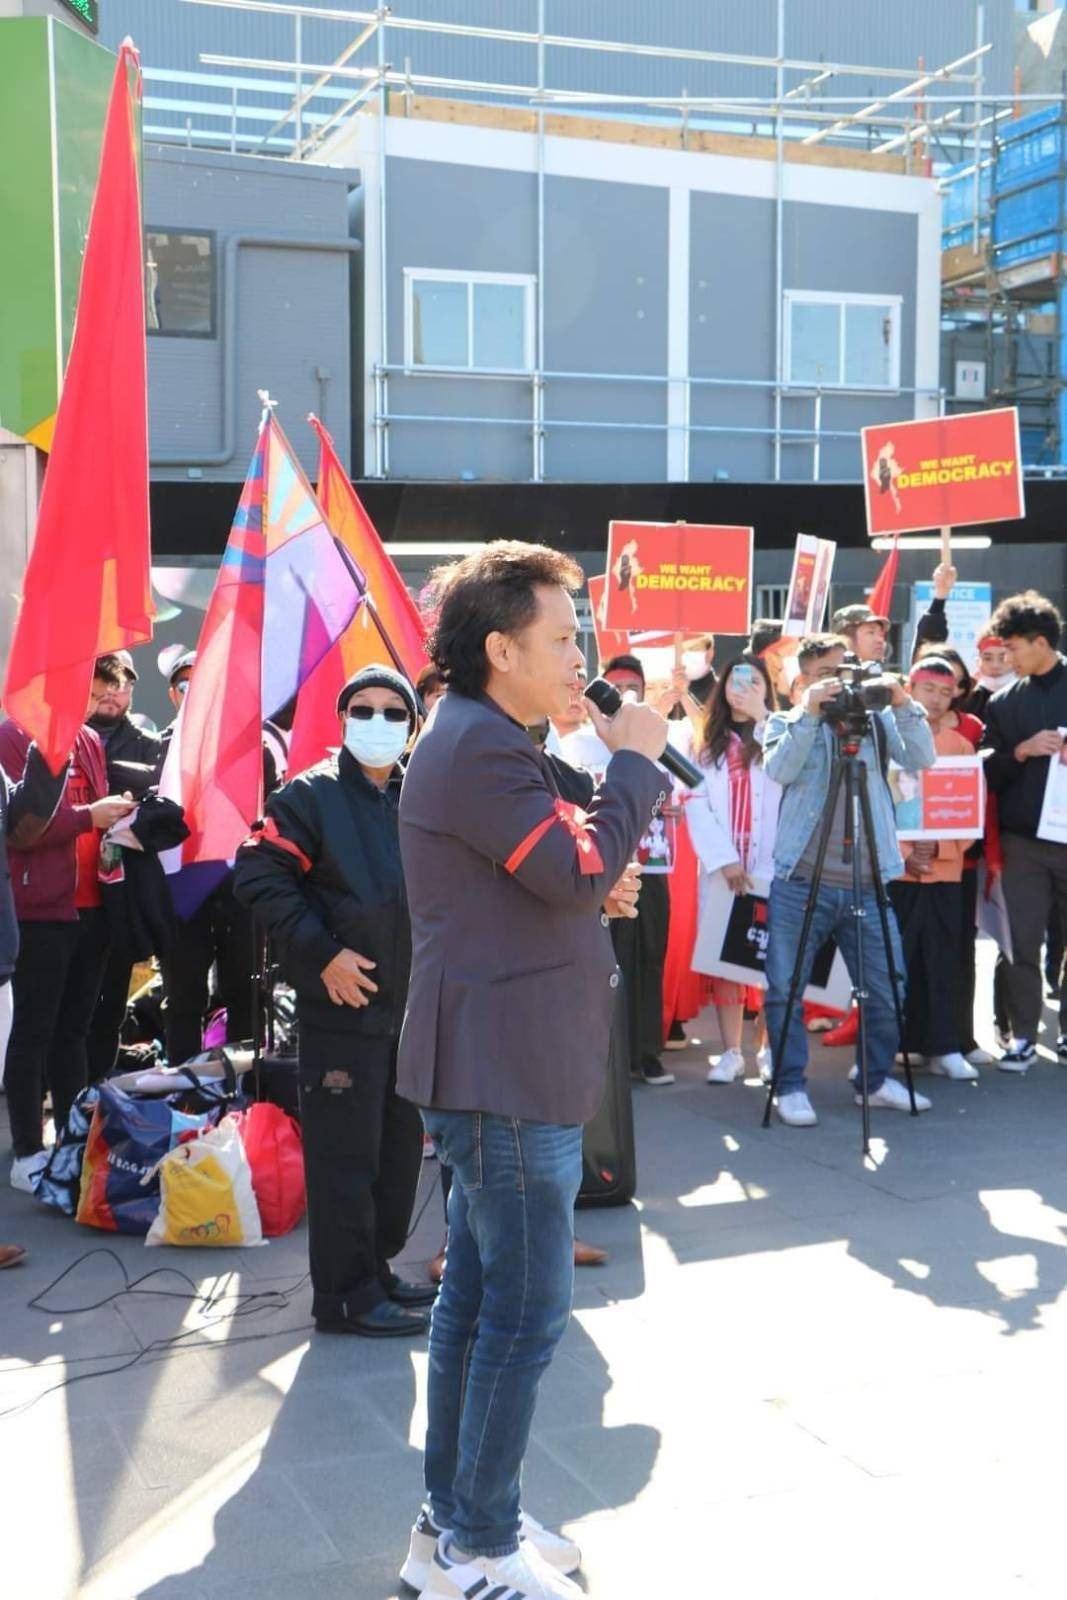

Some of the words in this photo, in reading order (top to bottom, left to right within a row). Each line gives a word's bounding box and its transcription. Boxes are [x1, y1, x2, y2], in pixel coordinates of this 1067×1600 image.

[920, 459, 939, 470] WE
[942, 455, 976, 467] WANT
[896, 461, 1014, 488] DEMOCRACY
[659, 563, 677, 574] WE
[680, 565, 712, 575] WANT
[636, 575, 746, 592] DEMOCRACY
